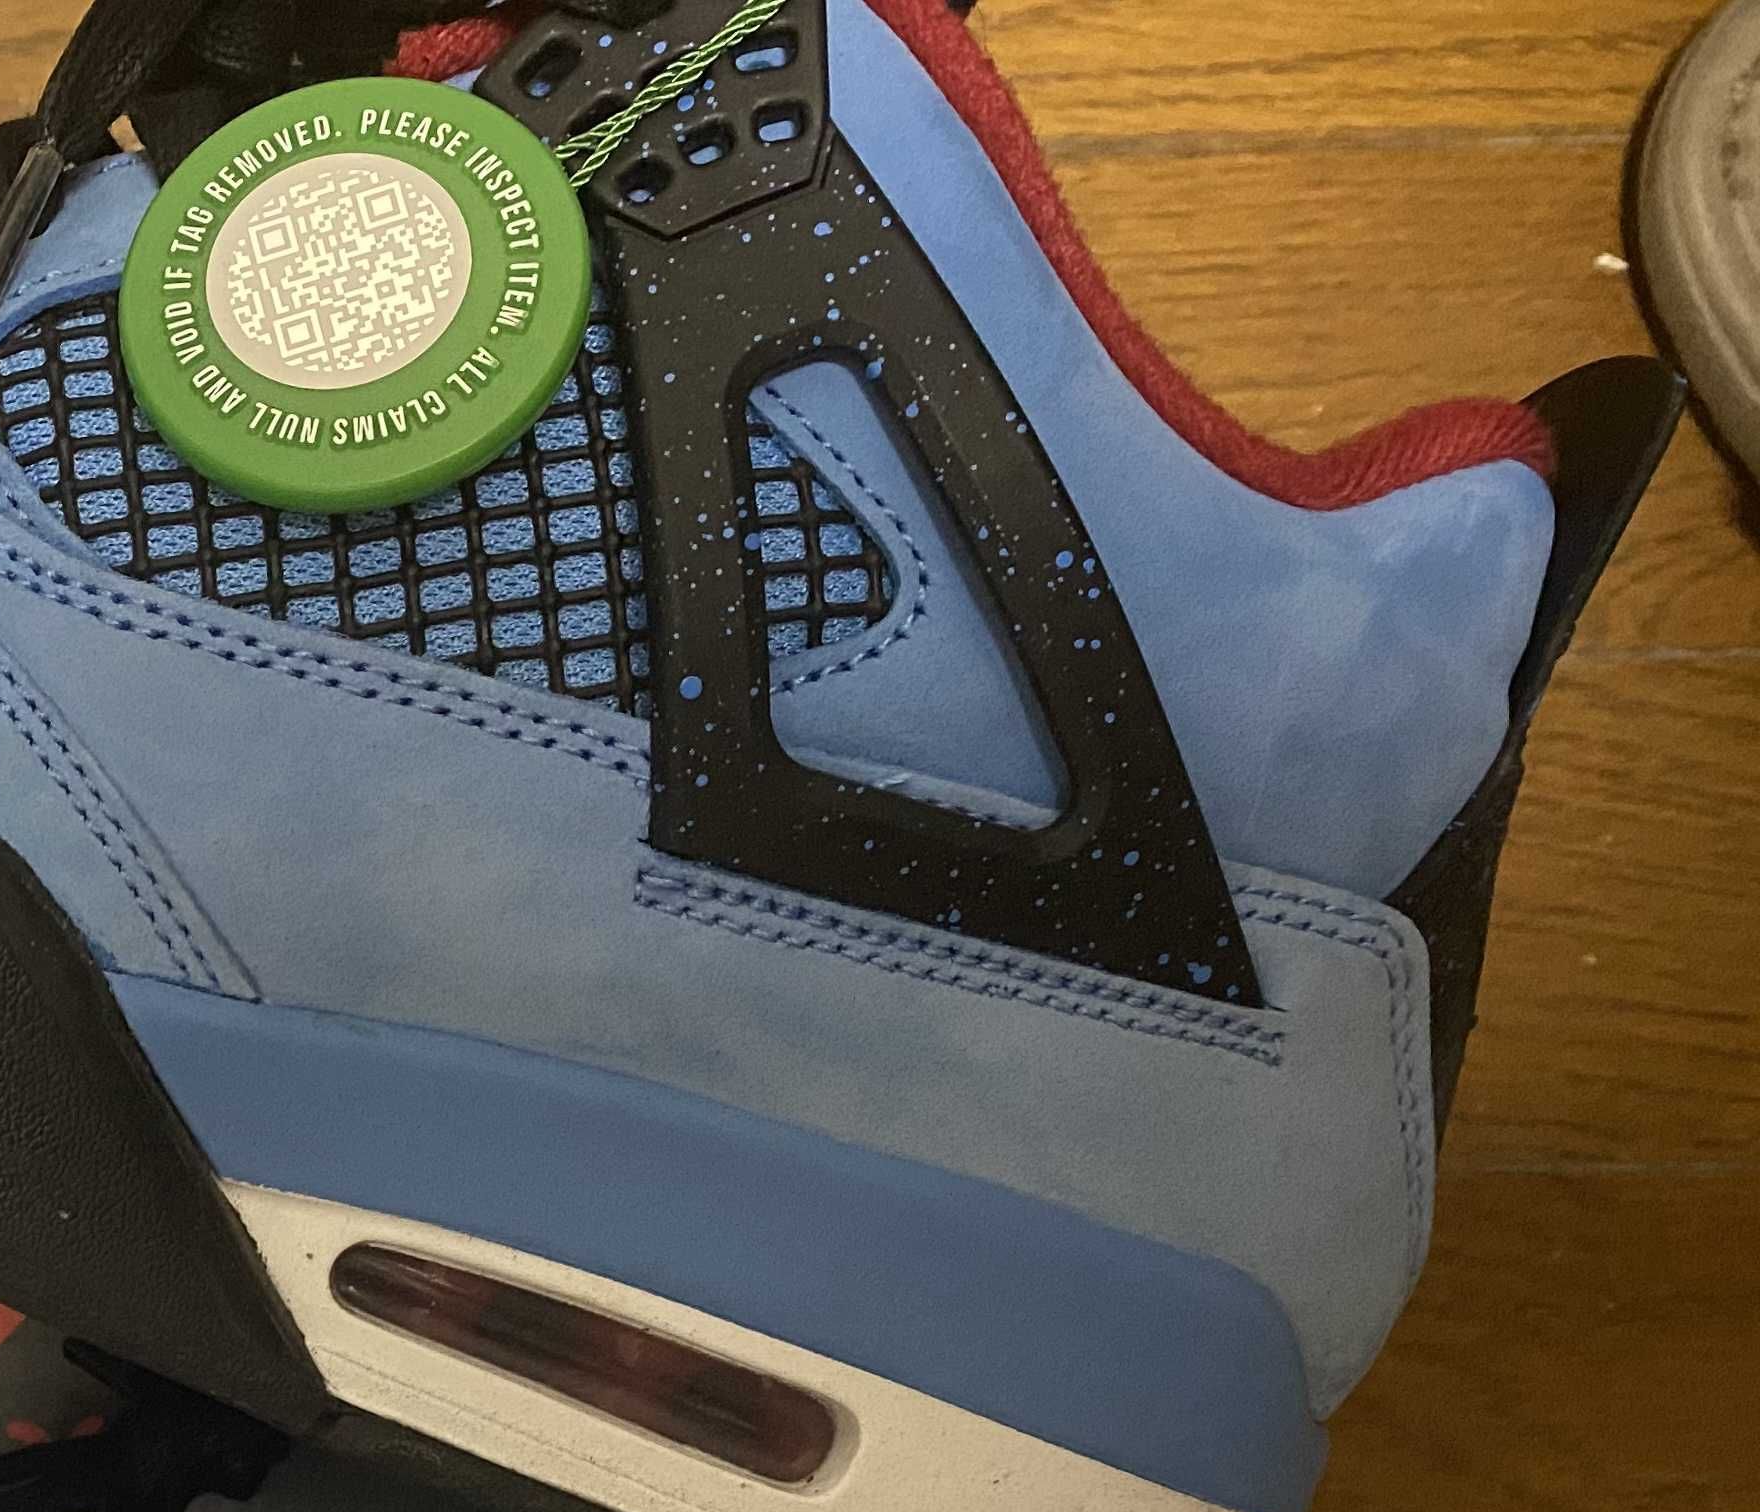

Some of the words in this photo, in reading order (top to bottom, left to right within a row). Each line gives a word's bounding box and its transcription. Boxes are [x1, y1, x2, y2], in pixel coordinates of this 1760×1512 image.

[360, 108, 470, 157] PLEASE
[203, 113, 342, 203] REMOVED.
[464, 146, 540, 255] INSPECT
[170, 206, 214, 254] TAG
[162, 266, 193, 291] IF
[491, 262, 540, 335] ITEM.
[164, 301, 205, 365] VOID
[192, 364, 248, 414] AND
[446, 346, 502, 395] ALL
[249, 401, 320, 444] NULL
[332, 394, 446, 445] CLAIMS
